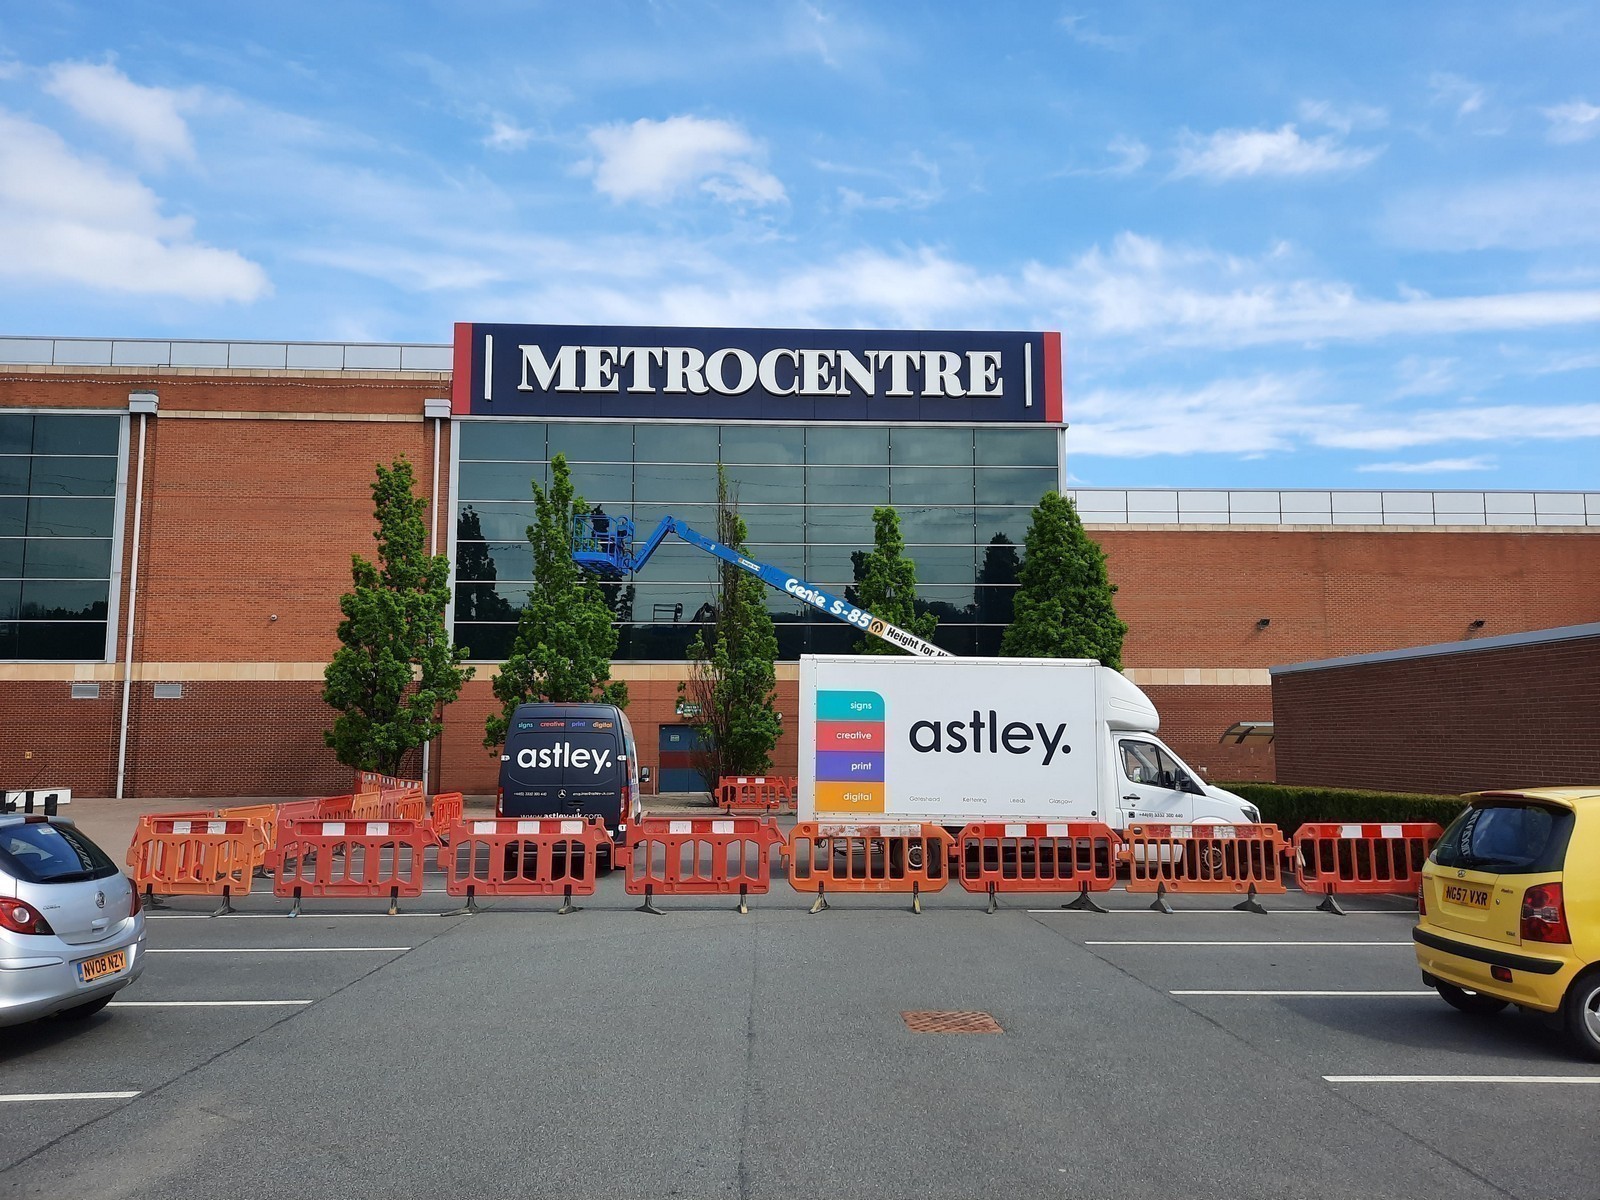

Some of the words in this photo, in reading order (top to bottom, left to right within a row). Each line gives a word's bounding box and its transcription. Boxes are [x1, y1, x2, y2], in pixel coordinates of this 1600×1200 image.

[517, 344, 1003, 397] METROCENTRE
[785, 578, 825, 608] Genie
[830, 600, 872, 628] S-85
[887, 627, 919, 650] Height
[919, 643, 935, 656] for
[850, 701, 872, 711] signs
[836, 730, 872, 740] creative
[909, 710, 1072, 766] astley.
[517, 742, 612, 774] astley.
[851, 761, 872, 772] print
[843, 792, 872, 802] digital
[1446, 886, 1467, 902] NG57
[1470, 890, 1488, 906] VXR
[83, 958, 107, 977] NV08
[107, 953, 124, 970] NZY
